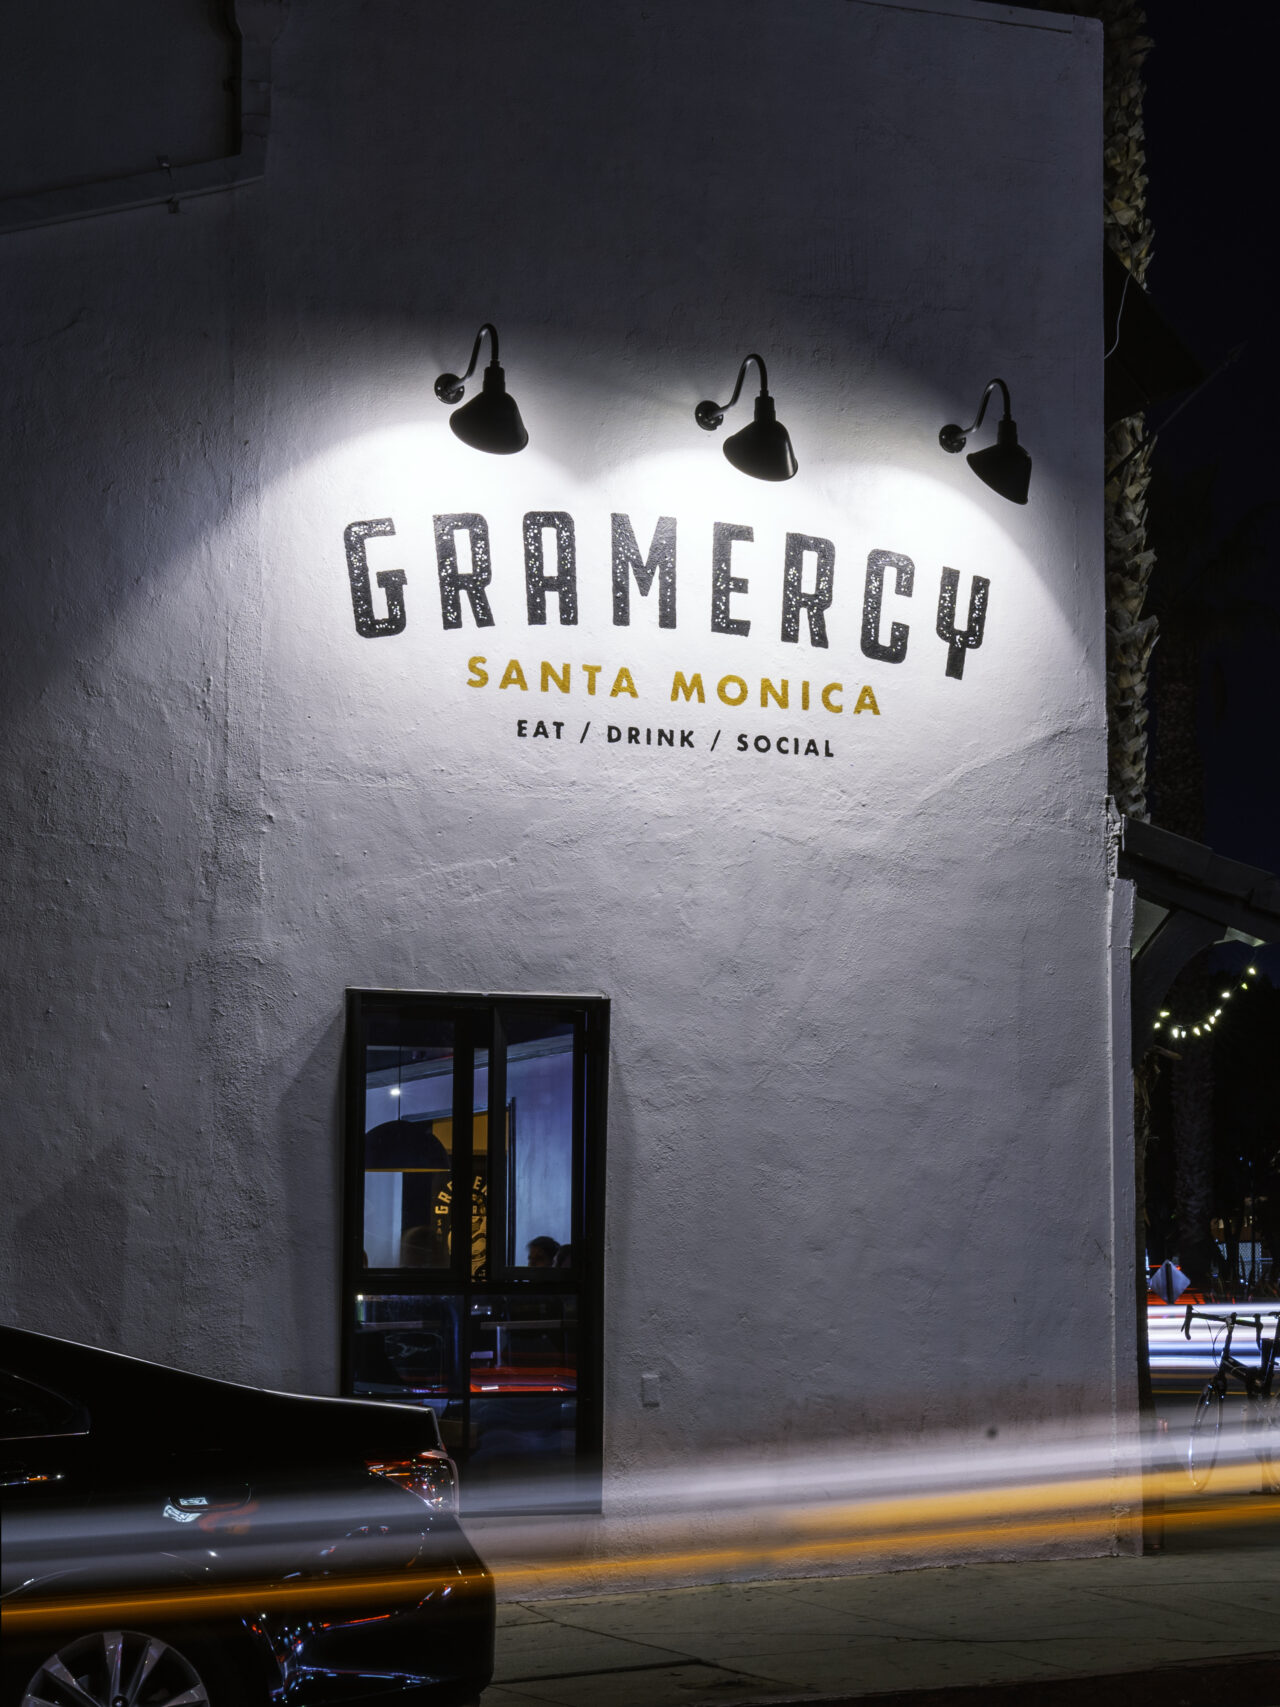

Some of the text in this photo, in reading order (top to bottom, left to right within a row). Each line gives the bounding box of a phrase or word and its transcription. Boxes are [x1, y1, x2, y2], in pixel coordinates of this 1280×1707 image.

[343, 510, 990, 681] GRAMERCY
[466, 656, 882, 716] SANTA MONICA
[516, 719, 565, 740] EAT
[607, 725, 695, 748] DRINK
[736, 733, 836, 758] SOCIAL
